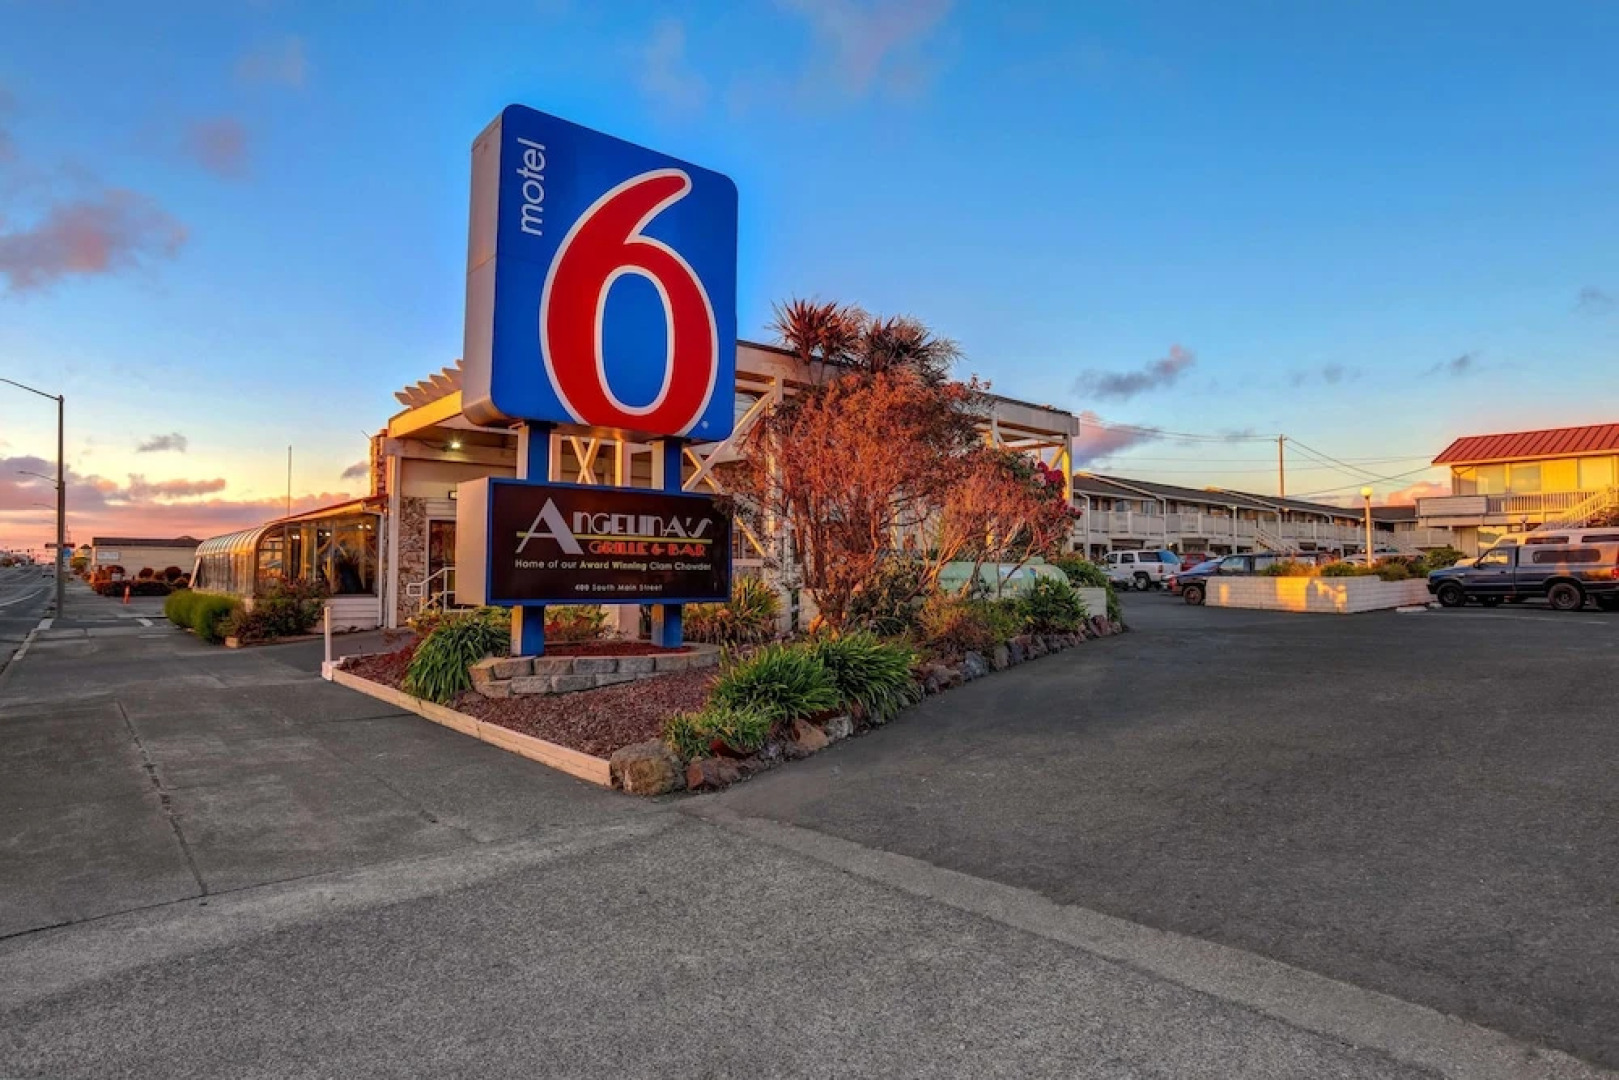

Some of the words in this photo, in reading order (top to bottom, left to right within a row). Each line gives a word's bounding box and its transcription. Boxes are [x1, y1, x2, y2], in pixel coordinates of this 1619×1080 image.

[517, 138, 546, 236] motel
[539, 168, 719, 436] 6
[651, 544, 666, 555] &
[668, 543, 706, 557] BAR
[515, 559, 545, 569] Home
[547, 560, 559, 569] of
[561, 561, 577, 569] our
[579, 561, 610, 570] Award
[612, 562, 647, 572] Winning
[649, 562, 673, 571] Clam
[674, 562, 712, 571] Chowder
[592, 584, 616, 592] South
[617, 584, 637, 592] Main
[639, 584, 663, 592] Street
